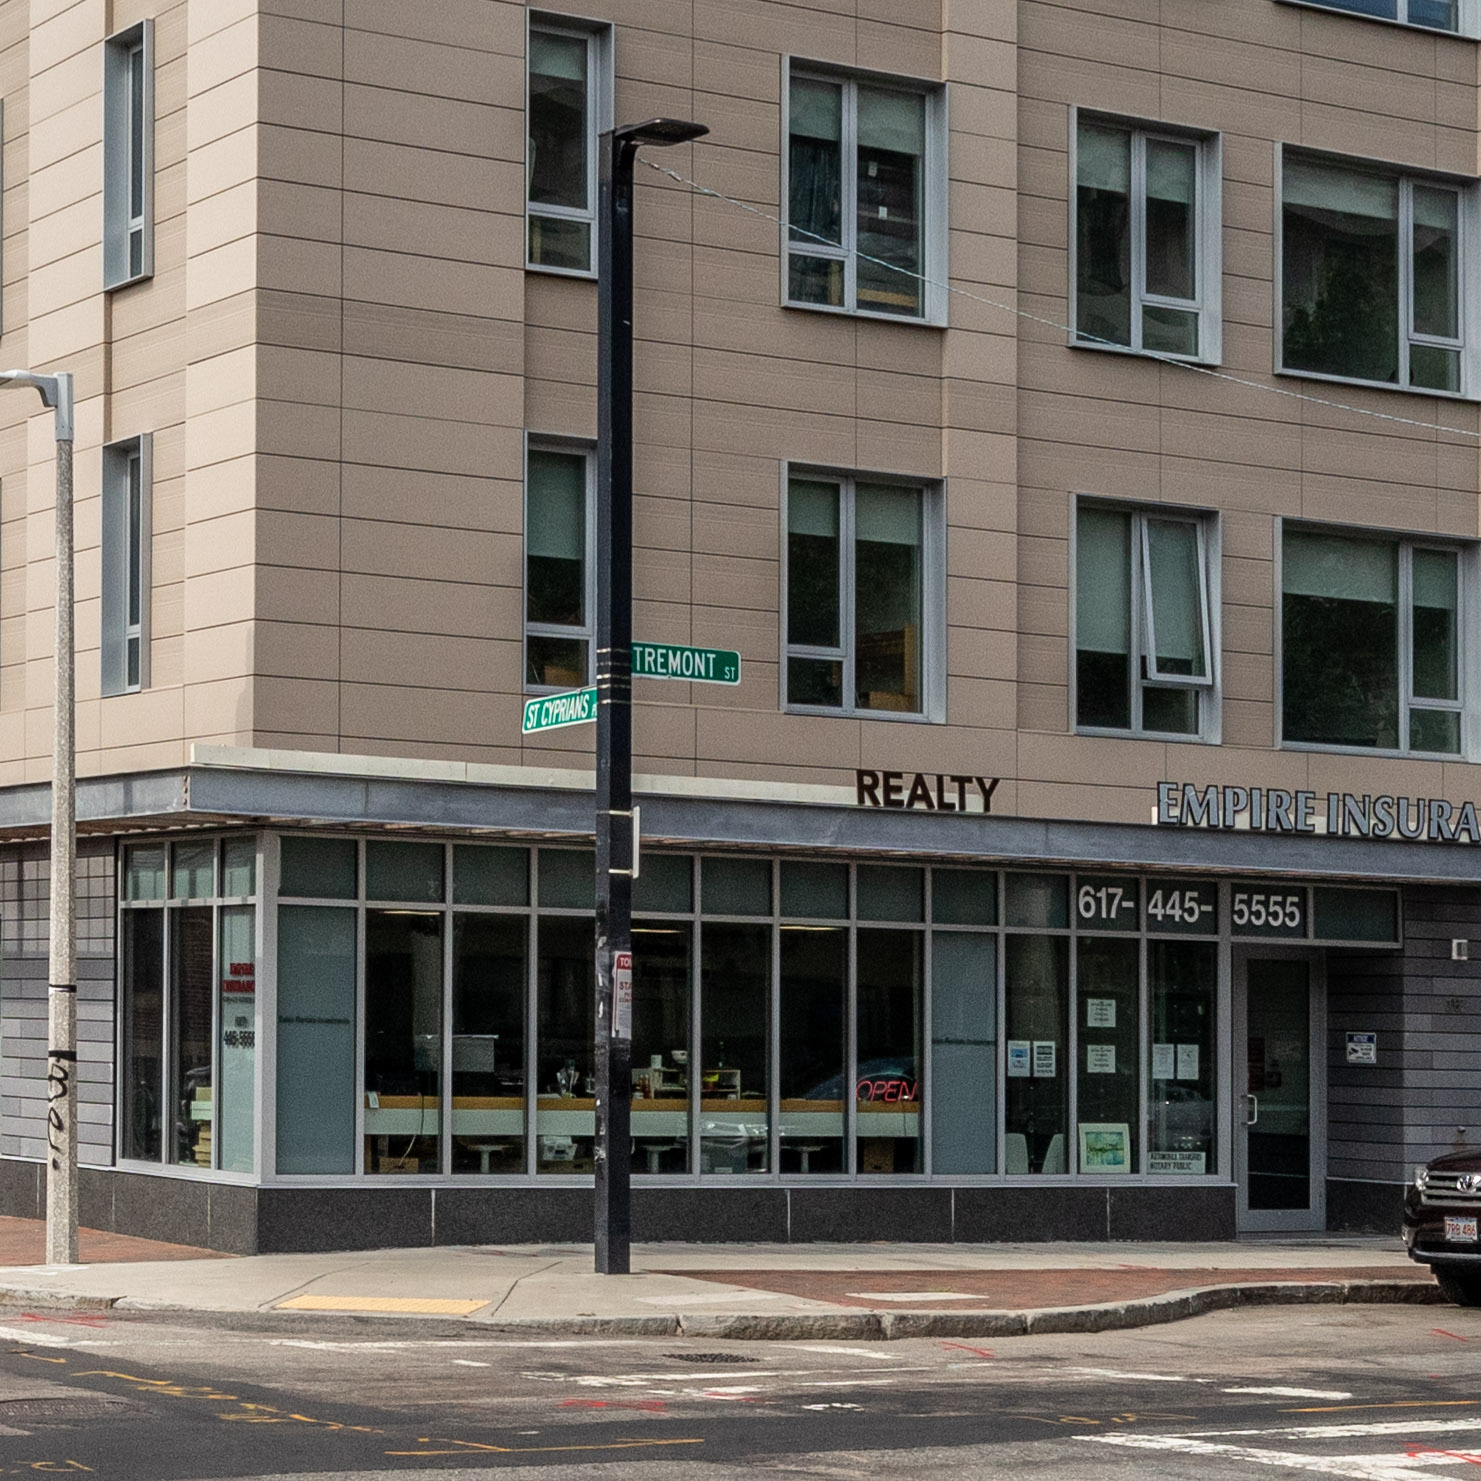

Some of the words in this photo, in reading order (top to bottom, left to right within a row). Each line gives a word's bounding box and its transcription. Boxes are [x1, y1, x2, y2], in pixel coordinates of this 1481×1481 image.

[633, 646, 716, 678] TREMONT
[724, 667, 736, 680] ST
[526, 702, 541, 729] ST
[541, 694, 589, 726] CYPRIANS
[856, 770, 1001, 813] REALTY
[1156, 780, 1317, 833] EMPIRE
[1078, 885, 1135, 919] 617-
[1148, 890, 1213, 924] 445-
[1233, 893, 1301, 928] 5555
[856, 1080, 918, 1102] OPEN
